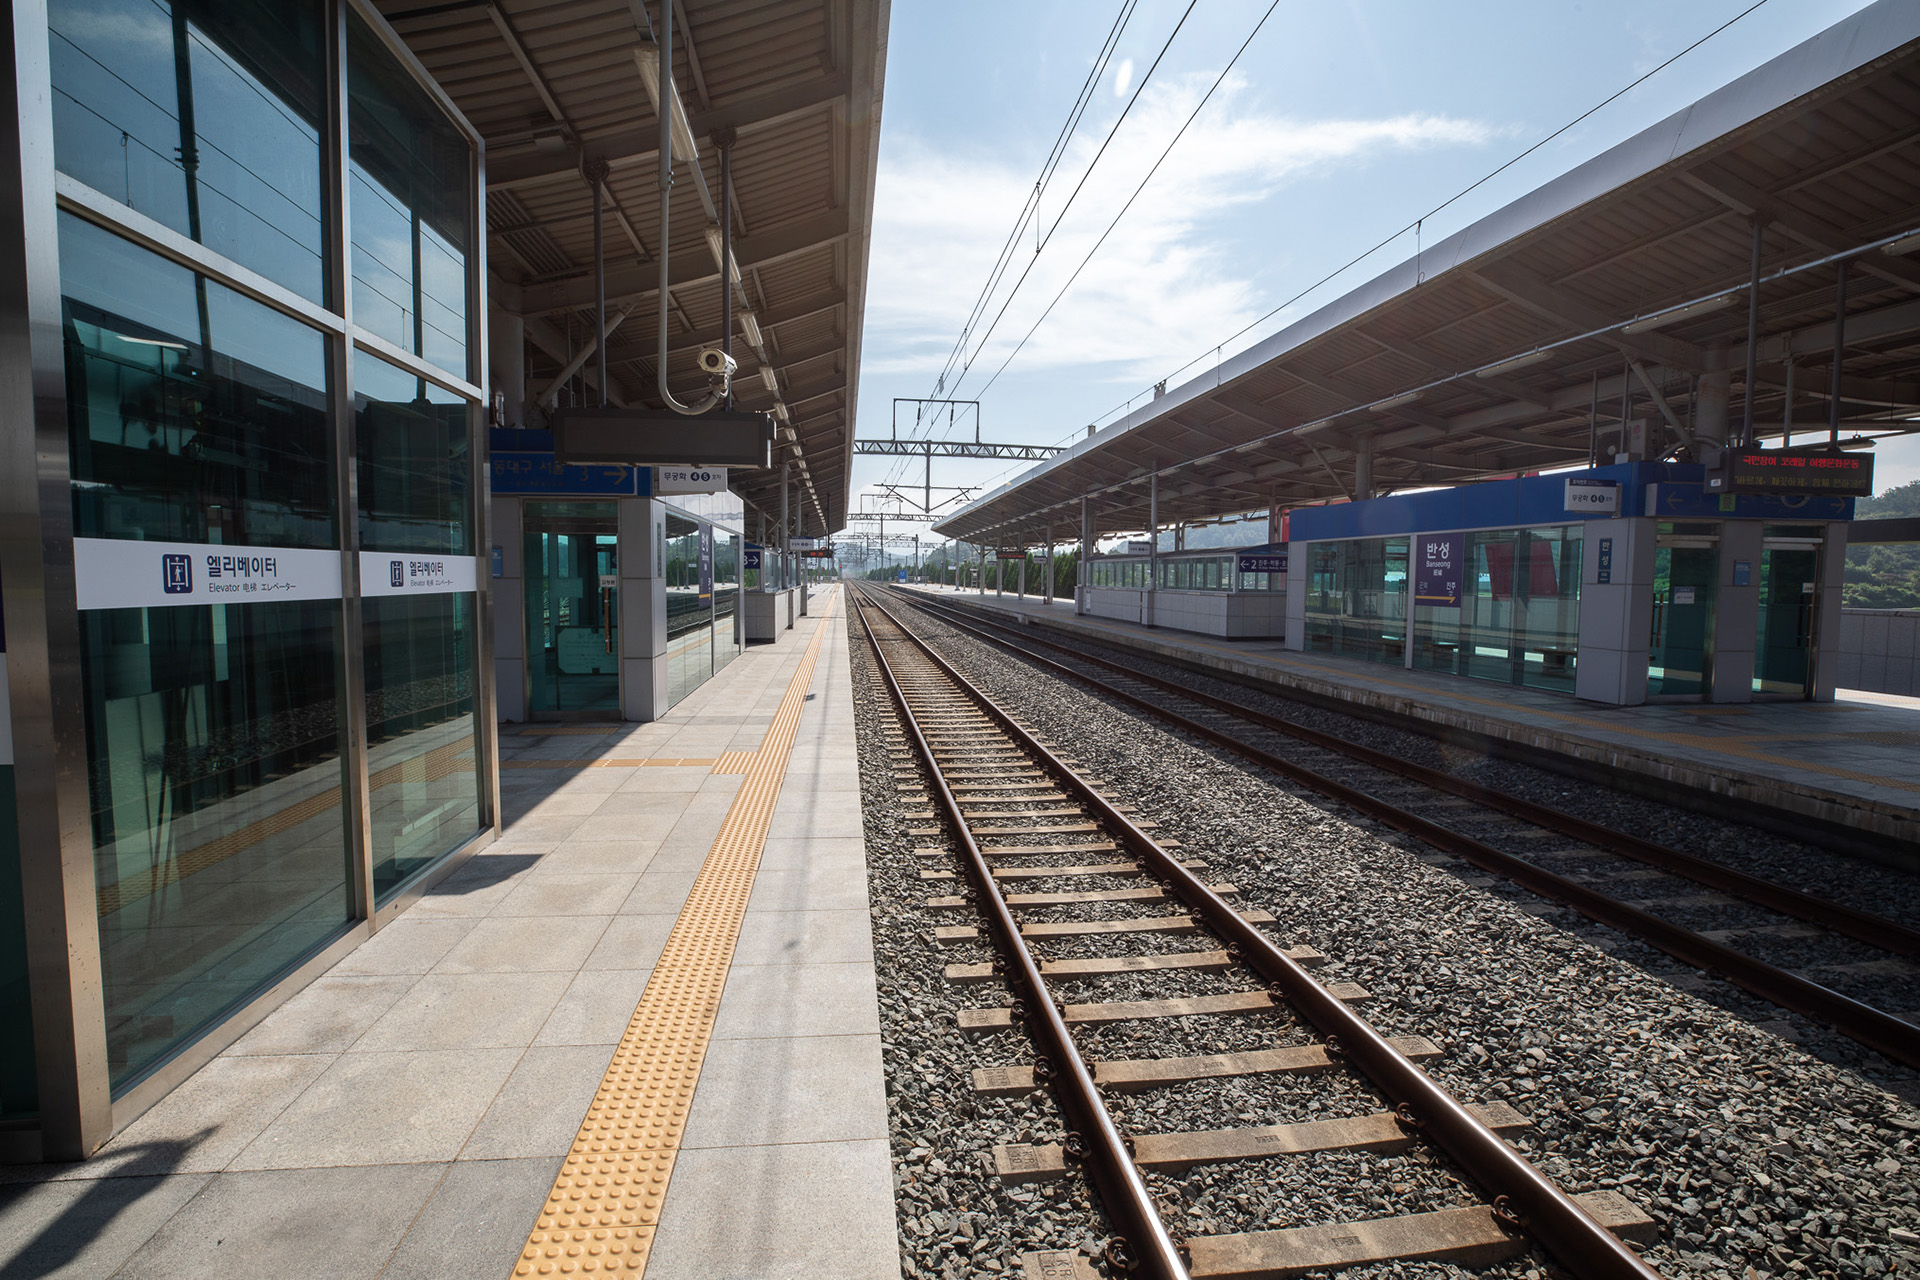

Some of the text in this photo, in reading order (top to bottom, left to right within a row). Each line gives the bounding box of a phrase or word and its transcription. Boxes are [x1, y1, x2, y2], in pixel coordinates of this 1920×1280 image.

[664, 472, 687, 481] 무궁화
[1426, 542, 1450, 559] 반성
[1602, 541, 1609, 566] 반성
[206, 554, 278, 578] 엘리베이터
[409, 561, 444, 577] 엘리베이터
[1251, 559, 1257, 569] 2
[1426, 560, 1450, 569] Banseong
[208, 582, 240, 593] Elevator
[261, 582, 297, 592] エレベーター
[410, 579, 425, 587] Elevator
